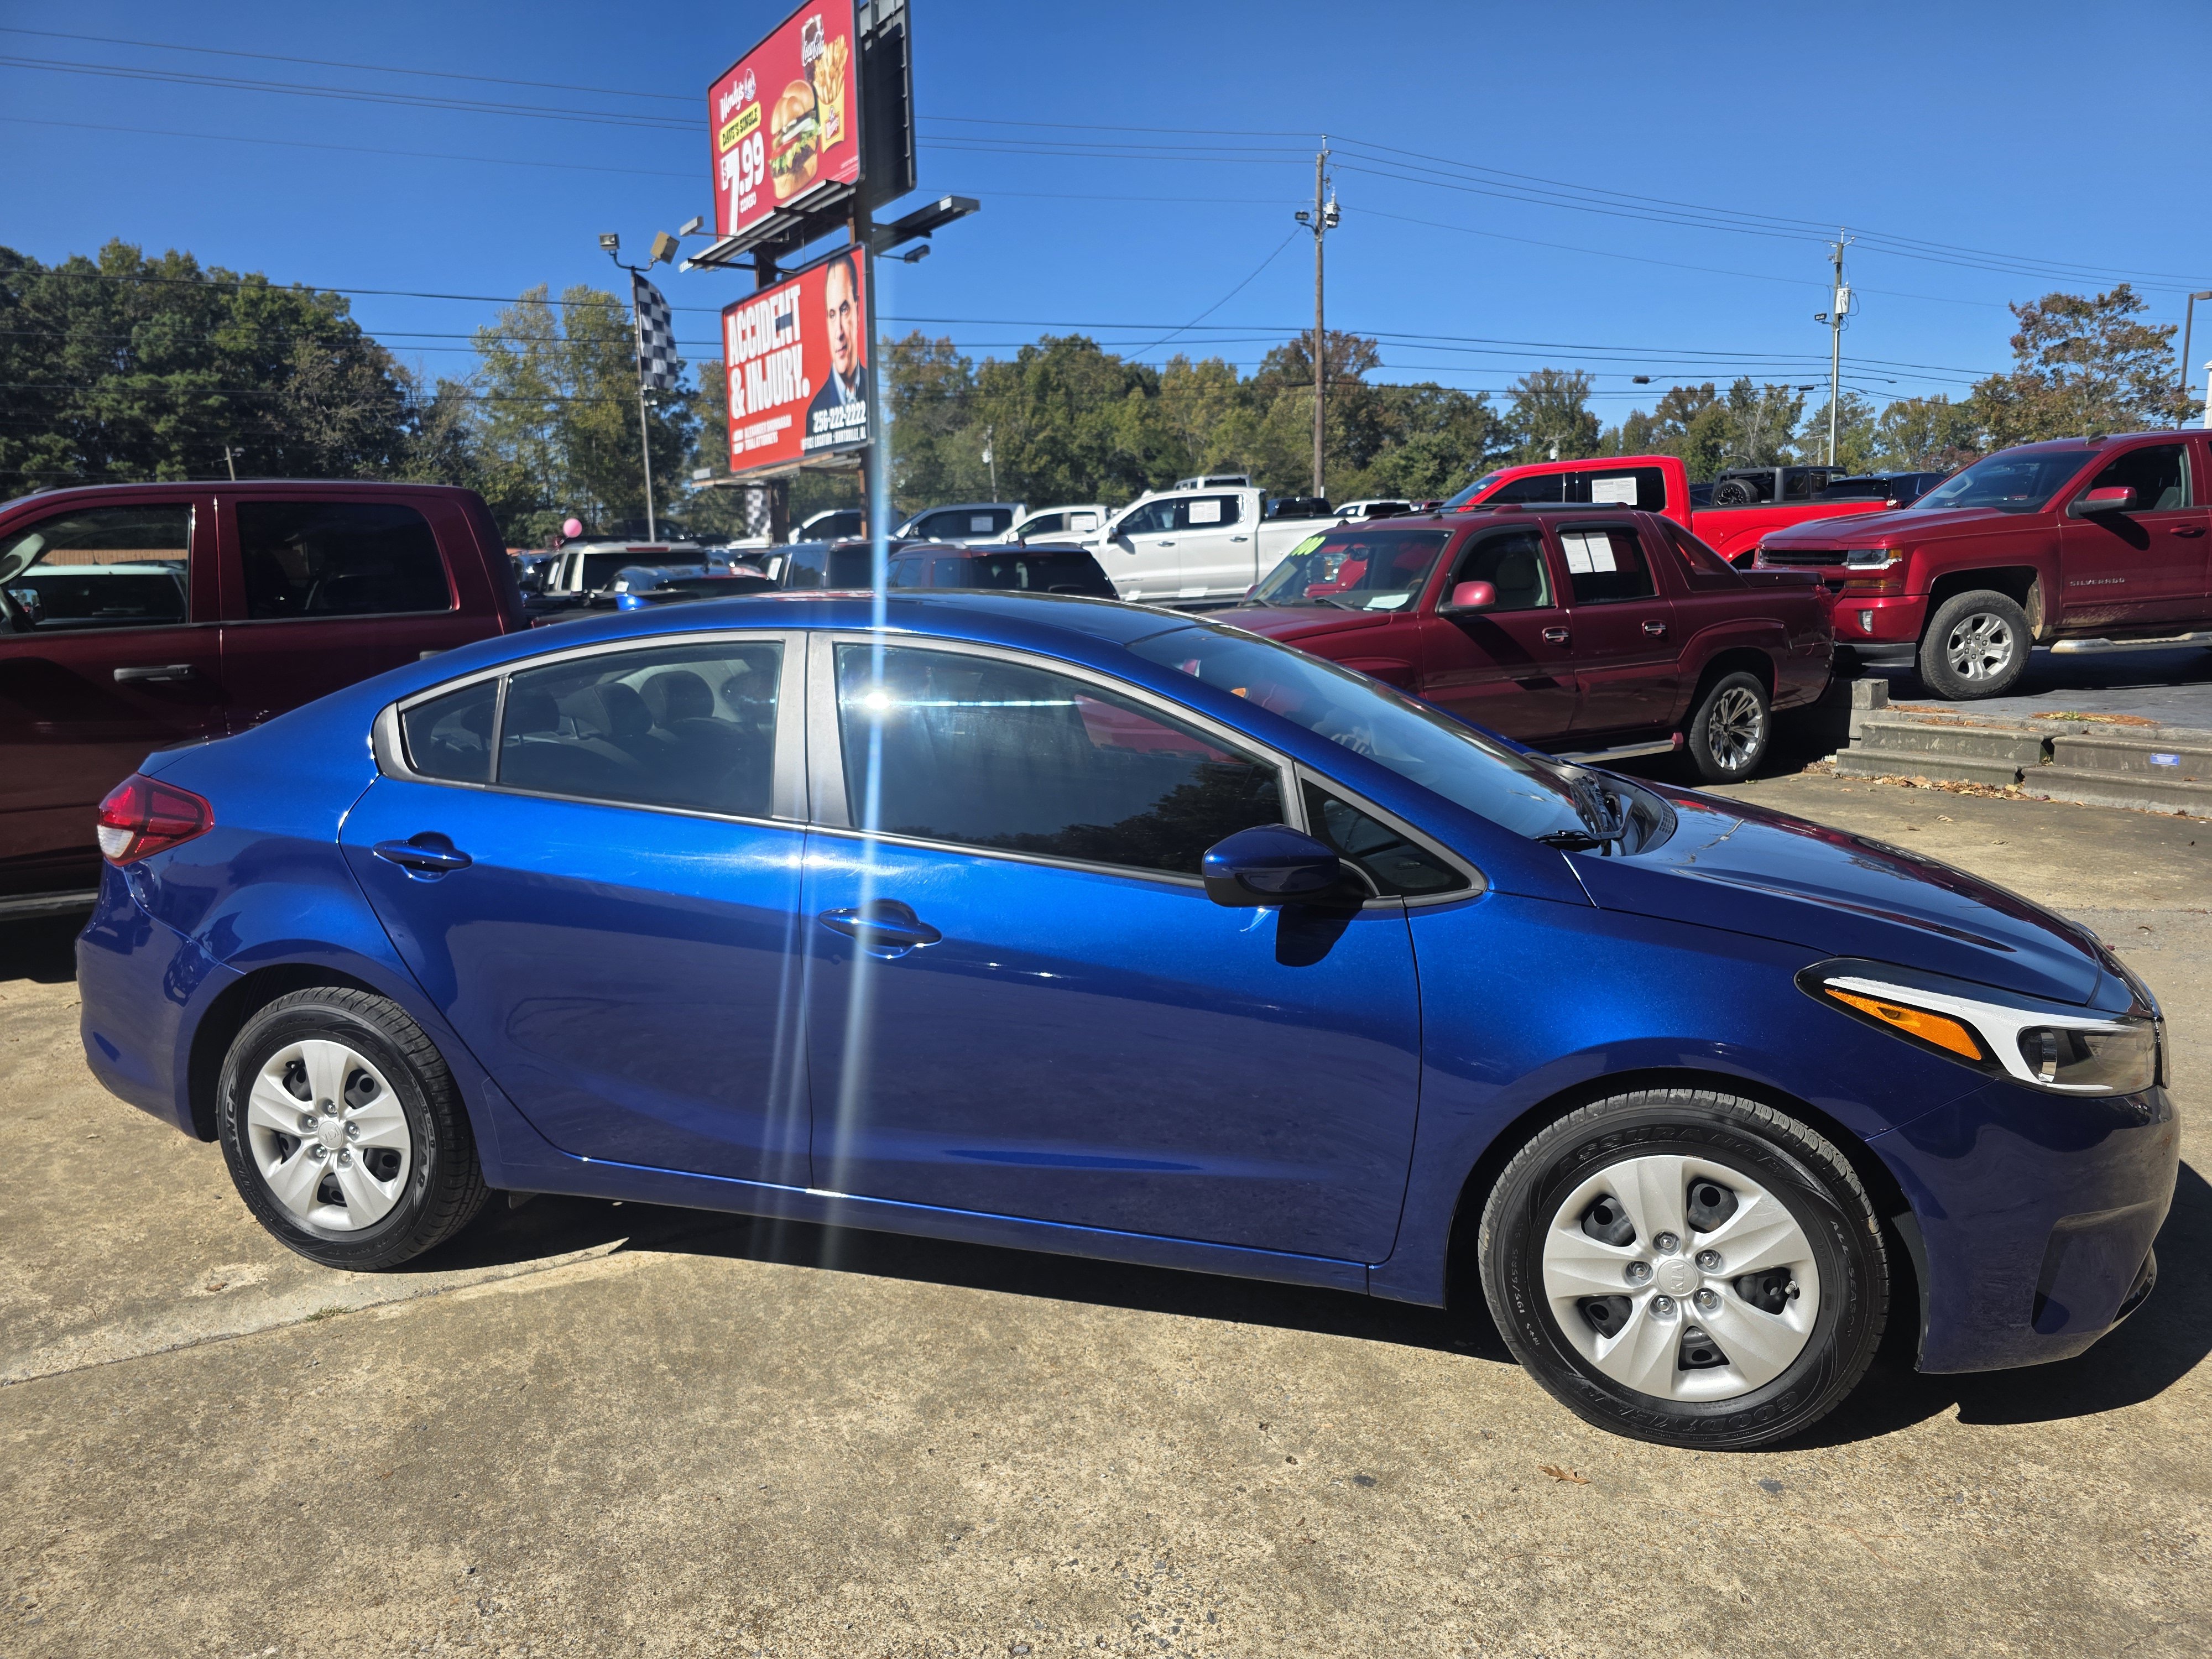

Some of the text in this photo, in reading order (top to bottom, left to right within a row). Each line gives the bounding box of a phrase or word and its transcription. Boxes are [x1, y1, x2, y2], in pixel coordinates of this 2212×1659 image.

[720, 80, 744, 123] Wendy's
[722, 107, 758, 148] DAVE'S SINGLE
[727, 284, 801, 367] ACCIDENT
[730, 343, 810, 419] & INJURY.
[812, 399, 867, 433] 256-222-2222
[2070, 578, 2125, 587] SILVERADO
[1558, 1126, 1787, 1176] ASSURANCE
[1671, 1264, 1684, 1292] KIA
